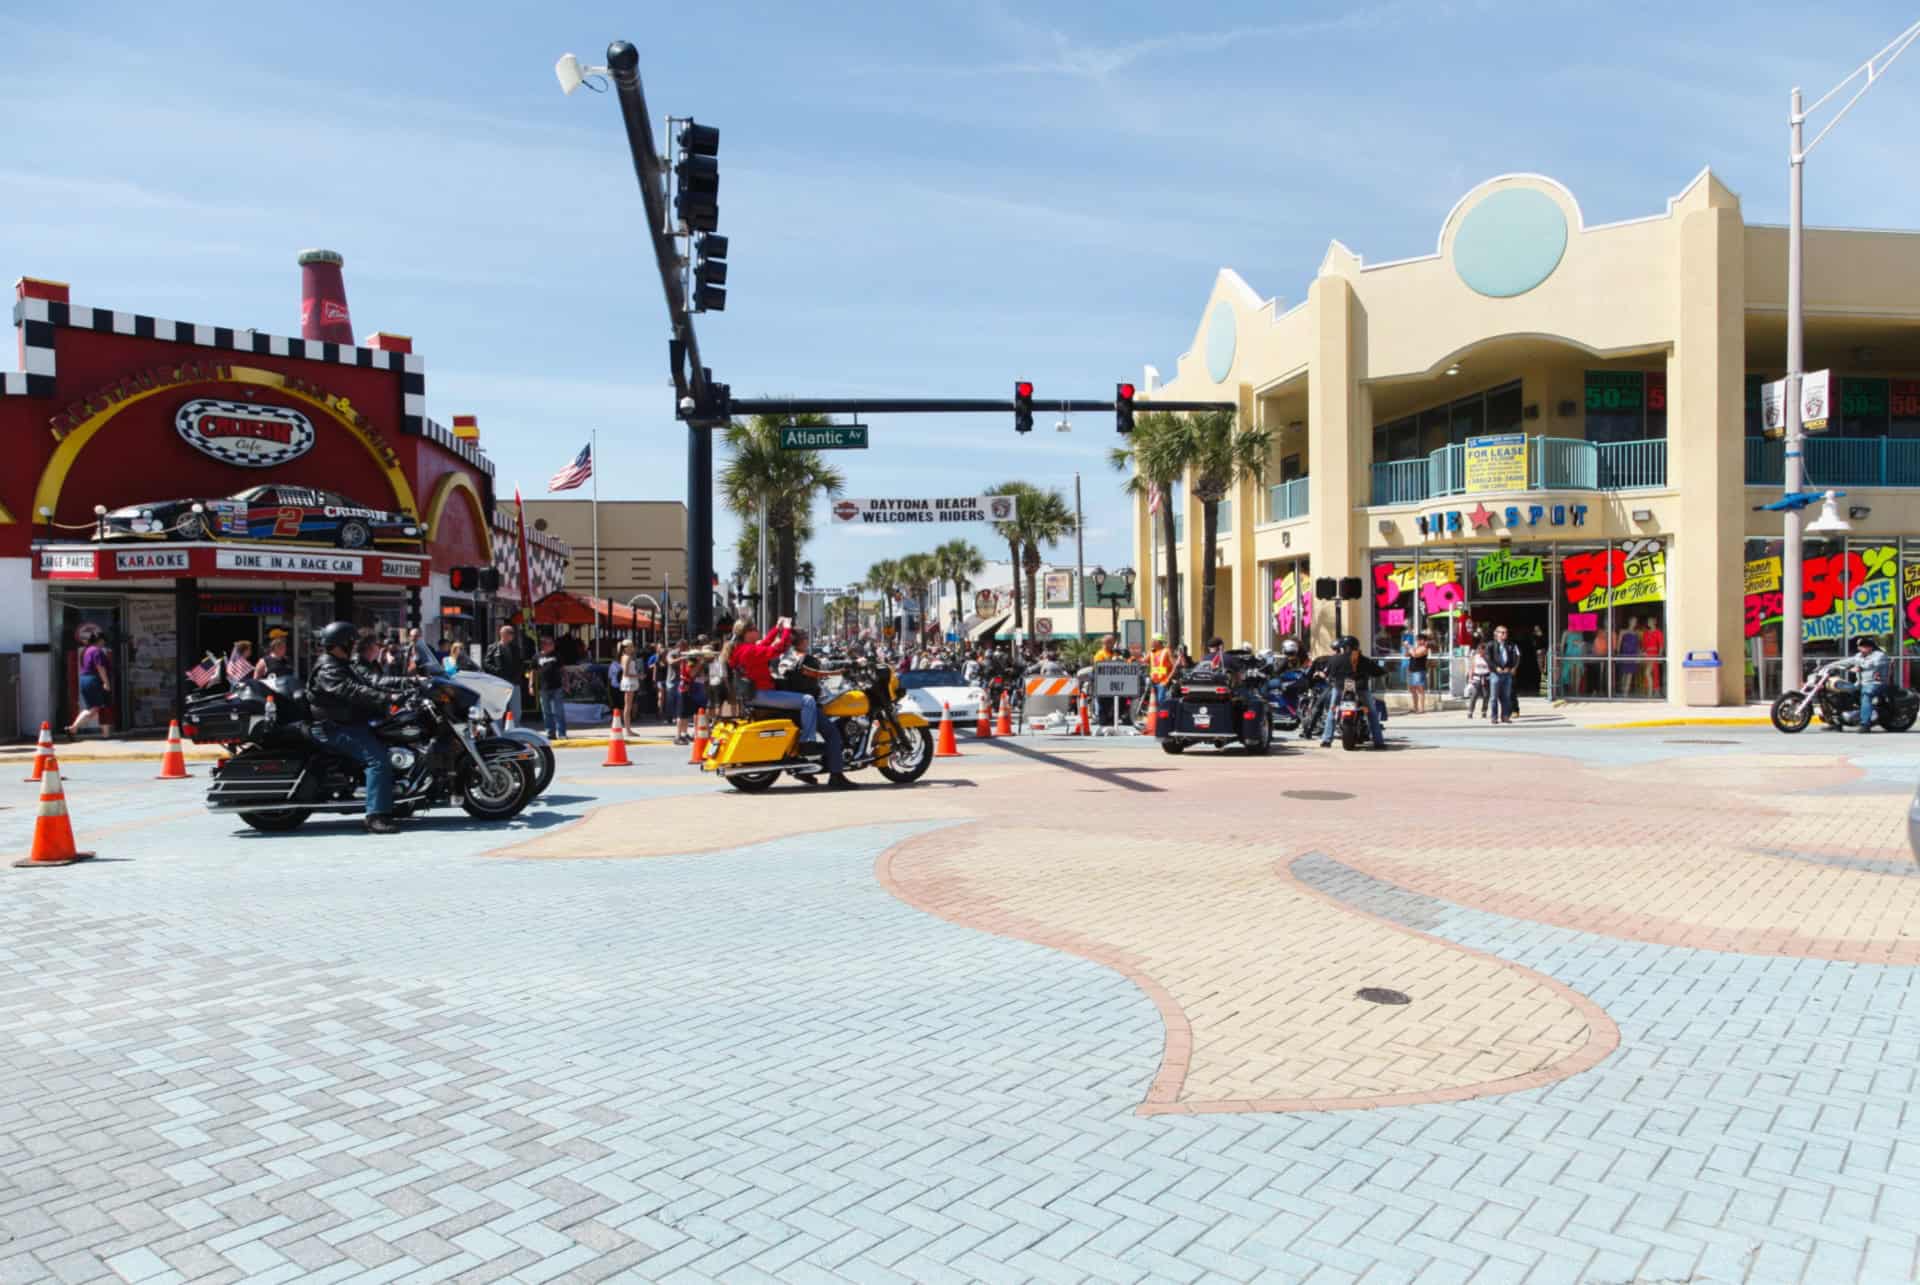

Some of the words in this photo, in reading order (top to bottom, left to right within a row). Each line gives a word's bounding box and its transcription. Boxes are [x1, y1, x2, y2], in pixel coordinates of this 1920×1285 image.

[786, 430, 845, 445] Atlantic
[848, 430, 863, 440] Av
[1468, 449, 1488, 459] FOR
[1491, 446, 1523, 457] LEASE
[870, 498, 929, 511] DAYTONA
[935, 497, 977, 510] BEACH
[272, 506, 304, 537] 2
[862, 510, 934, 523] WELCOMES
[939, 509, 985, 522] RIDERS
[1416, 510, 1462, 535] THE
[1505, 504, 1588, 528] SPOT
[41, 554, 63, 568] LARGE
[118, 554, 185, 567] KARAOKE
[234, 555, 261, 567] DINE
[271, 555, 283, 568] IN
[287, 557, 296, 568] A
[301, 558, 329, 570] RACE
[332, 560, 353, 571] CAR
[1626, 554, 1661, 577] OFF
[1478, 557, 1539, 588] Turtles!
[1854, 579, 1890, 606] OFF
[1848, 610, 1890, 636] STORE
[1096, 664, 1137, 676] MOTORCYCLES
[1110, 681, 1124, 692] ONLY
